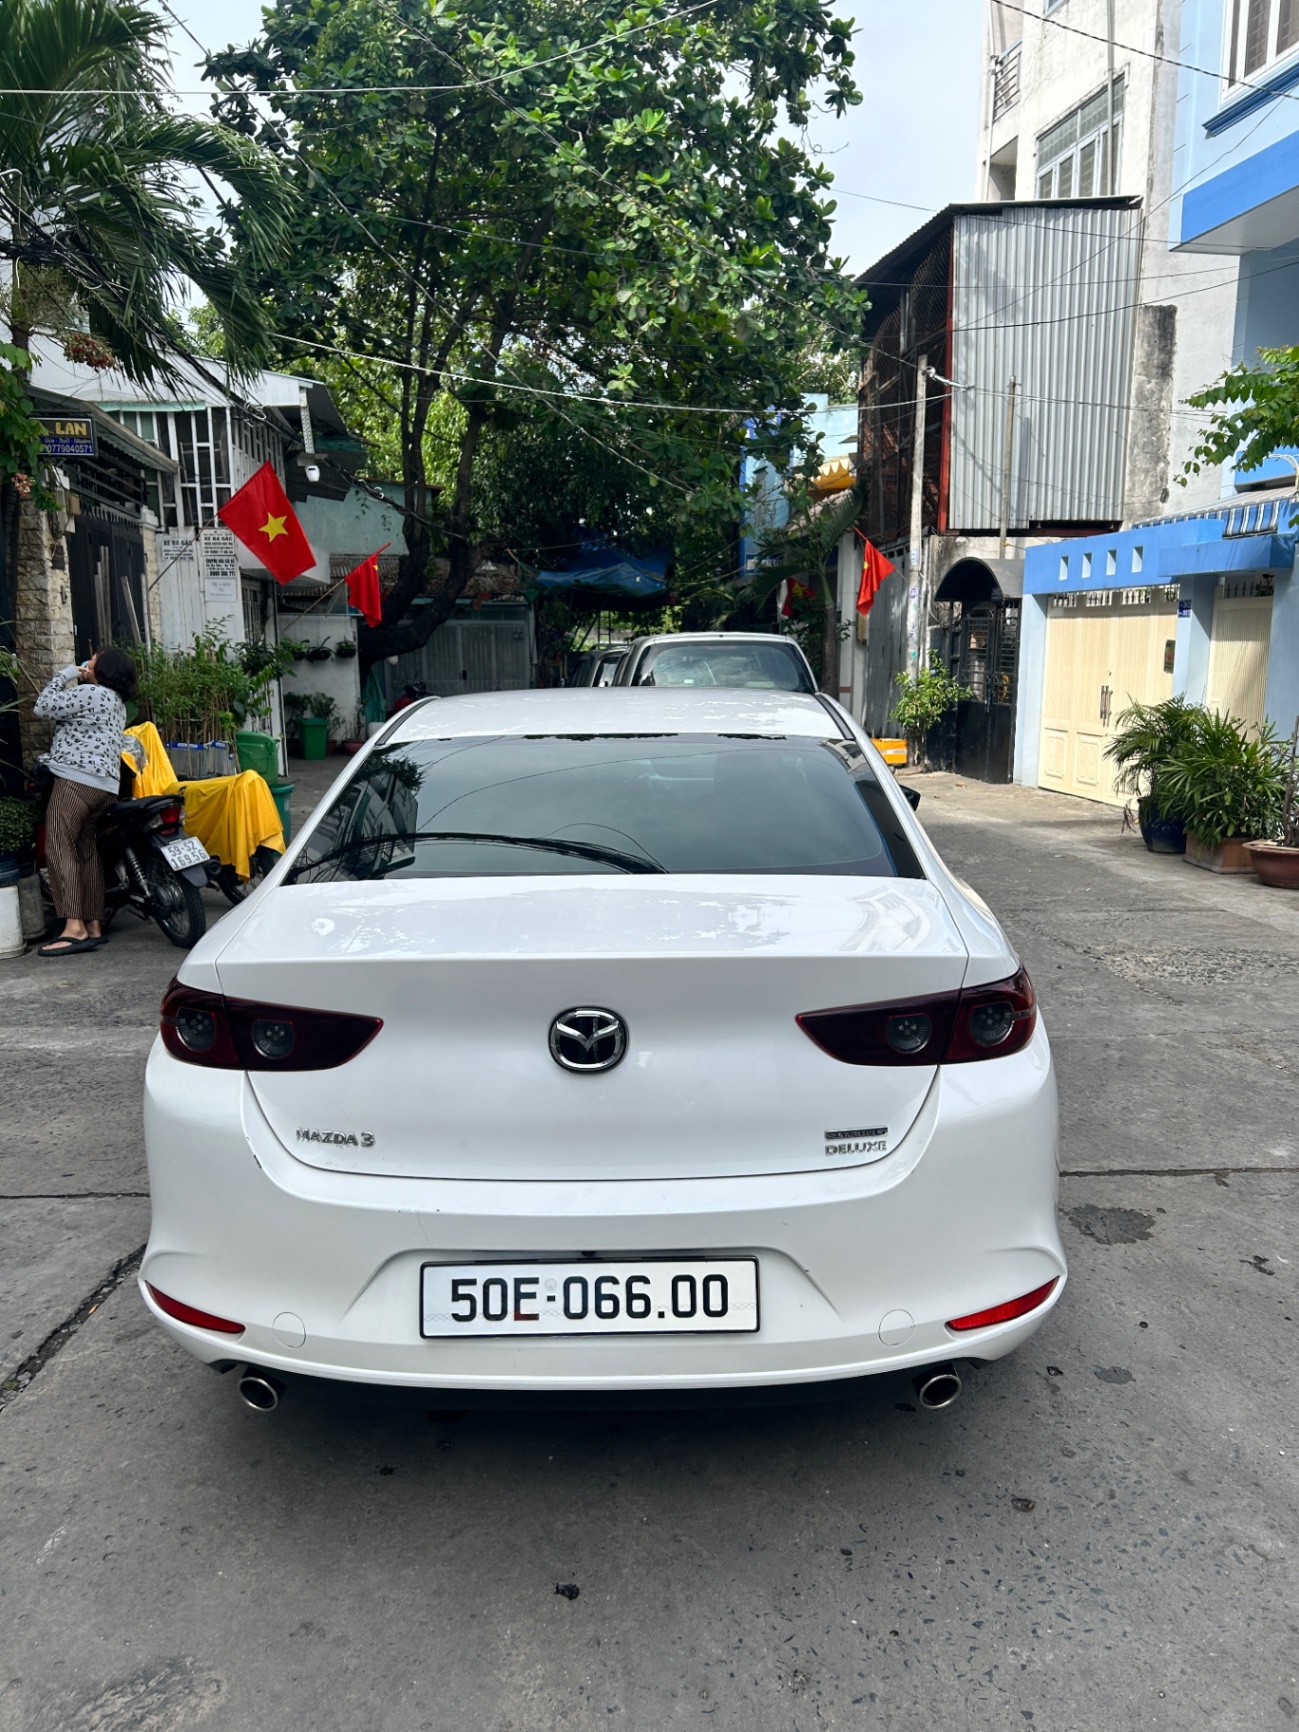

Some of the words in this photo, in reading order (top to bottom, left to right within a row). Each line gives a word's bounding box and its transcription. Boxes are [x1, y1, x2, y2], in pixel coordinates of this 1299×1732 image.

[56, 422, 87, 435] LAN
[168, 840, 197, 857] 59-S2
[171, 850, 206, 869] 169.56
[296, 1127, 358, 1146] MAZDA
[361, 1131, 375, 1147] 3
[825, 1140, 887, 1156] DELUXE
[451, 1274, 728, 1322] 50E-066.00
